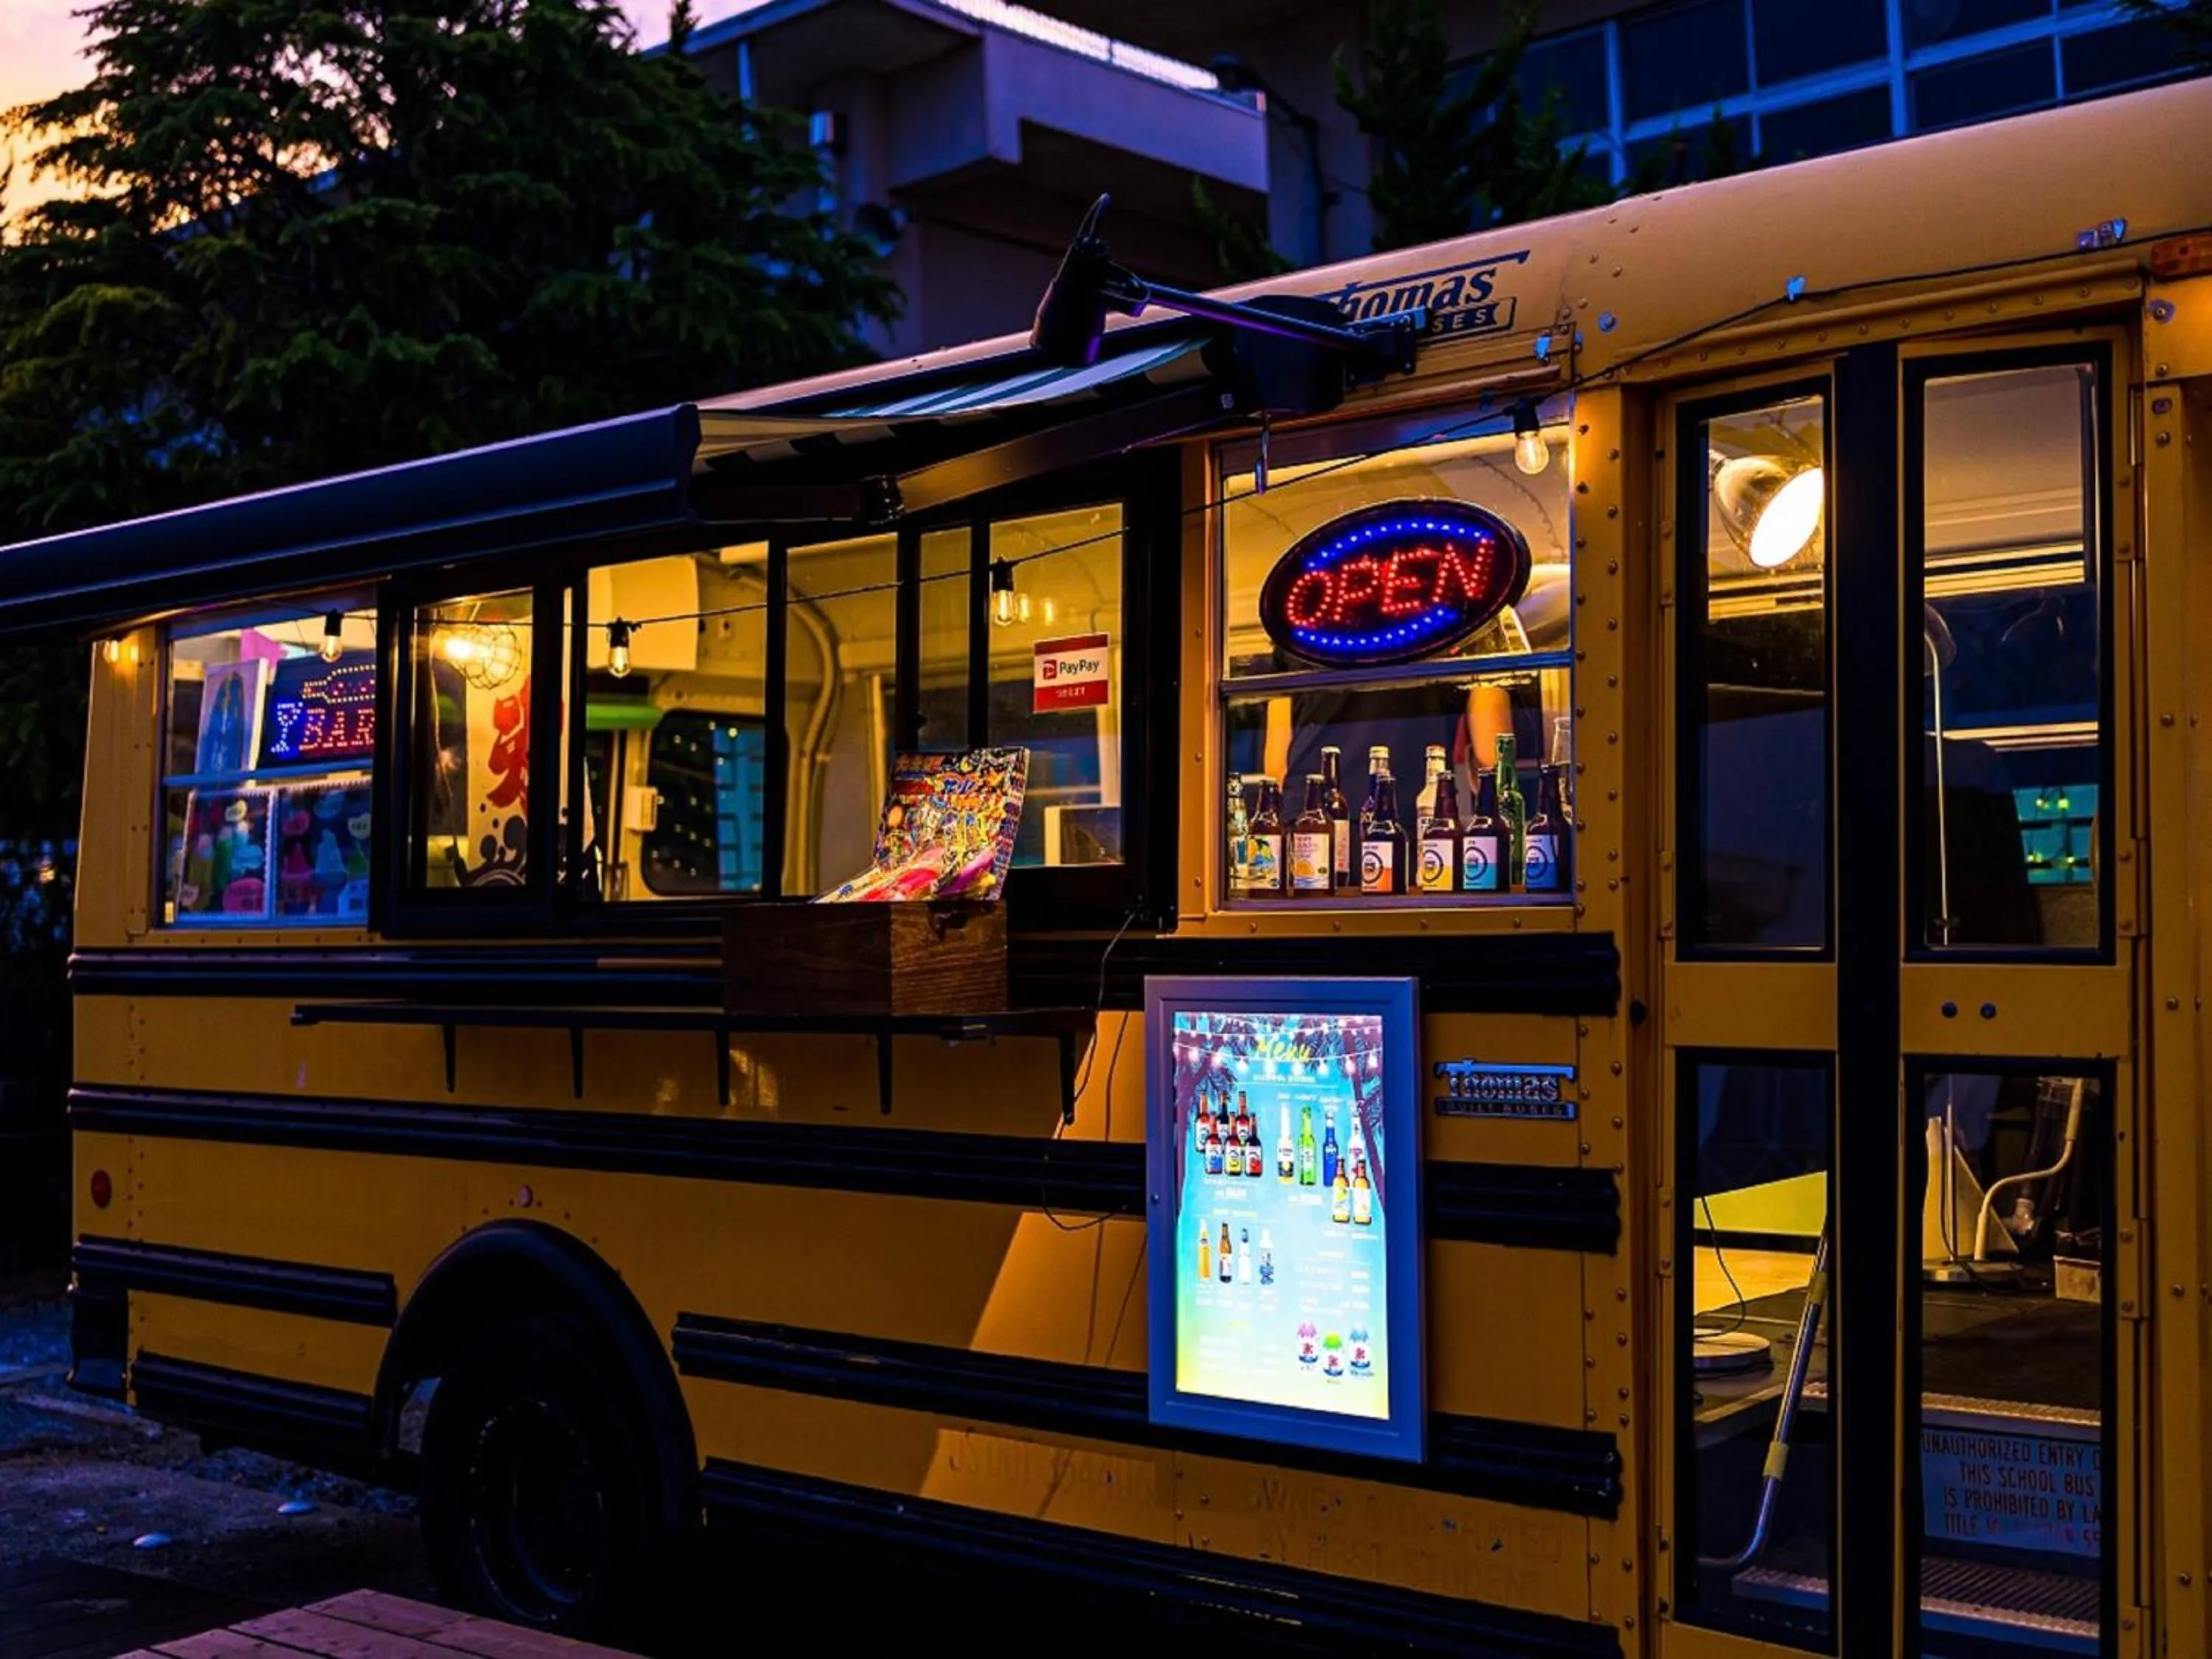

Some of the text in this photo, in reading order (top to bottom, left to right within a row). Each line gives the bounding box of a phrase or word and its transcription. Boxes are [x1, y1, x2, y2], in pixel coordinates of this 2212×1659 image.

[1333, 266, 1498, 323] homas
[1284, 539, 1495, 627] OPEN
[1060, 659, 1099, 675] PayPay
[299, 709, 375, 749] BAR
[1441, 1062, 1569, 1102] Thomas
[1921, 1431, 2101, 1471] UNAUTHORIZED ENTRY O
[1960, 1461, 2095, 1498] THIS SCHOOL BUS
[1944, 1486, 2101, 1523] IS PROHIBITED BY LA
